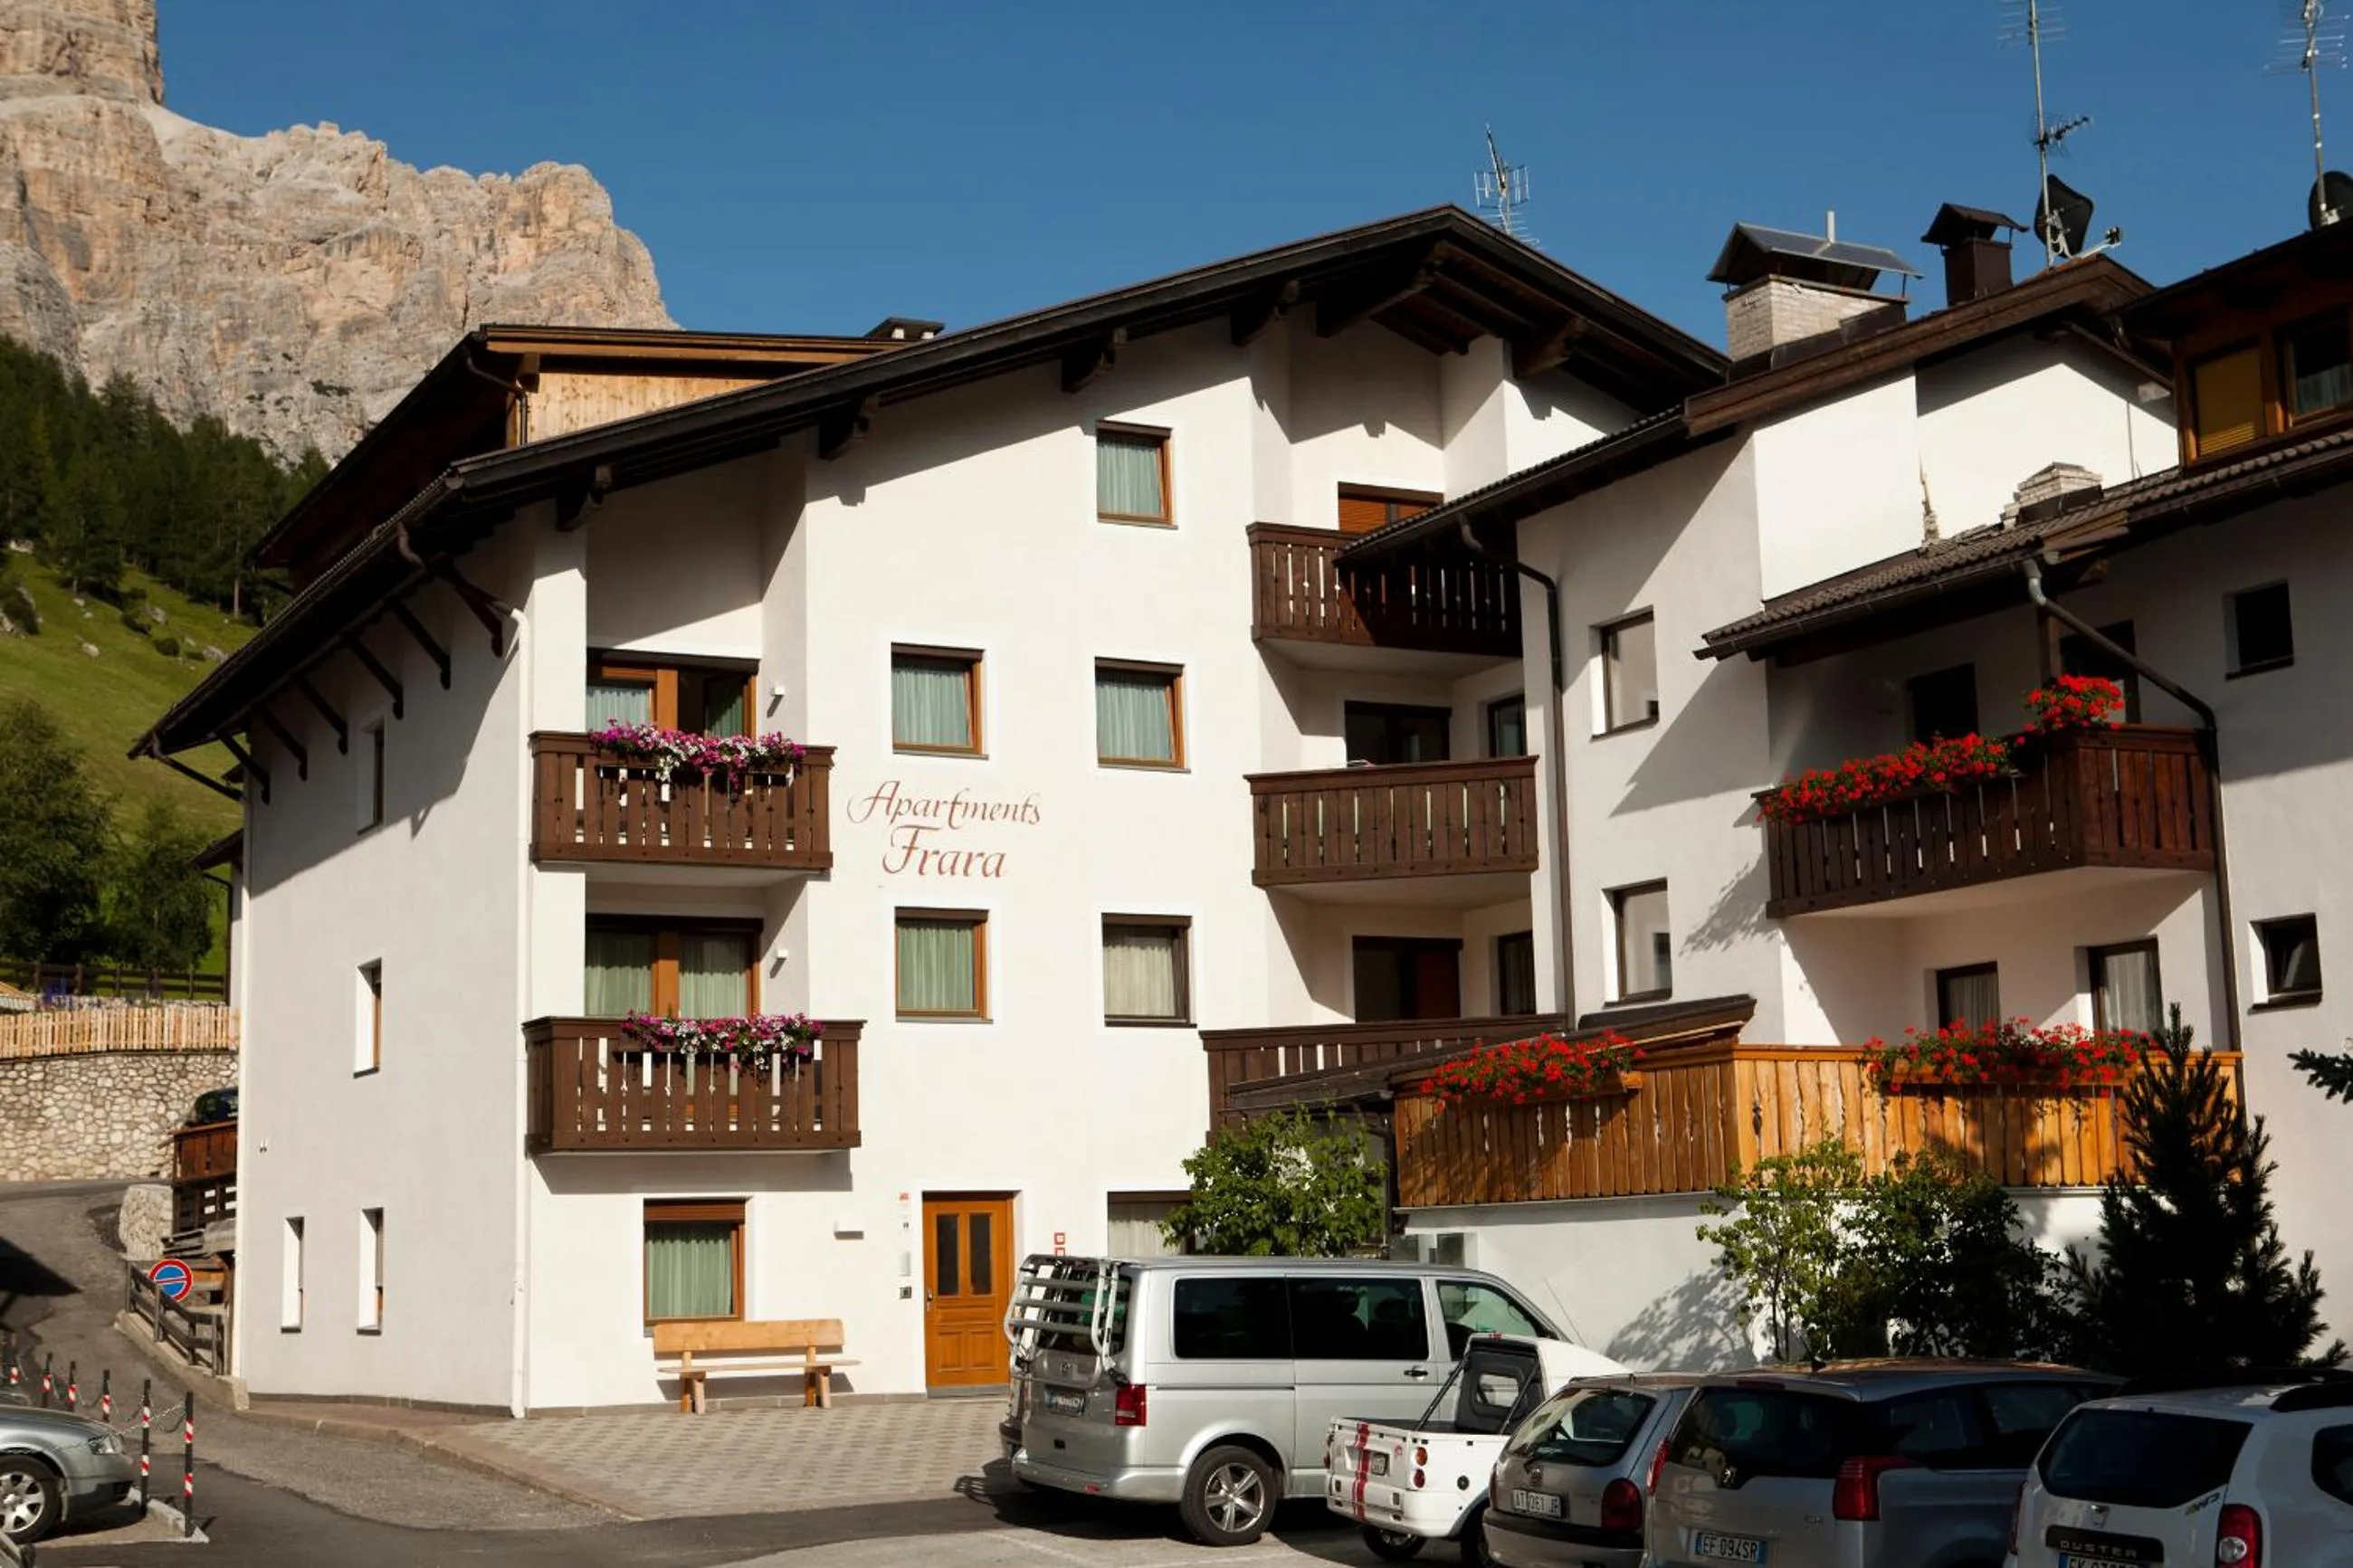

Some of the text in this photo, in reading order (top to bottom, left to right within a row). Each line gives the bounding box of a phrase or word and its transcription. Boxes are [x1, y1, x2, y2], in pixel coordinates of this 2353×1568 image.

[847, 780, 1040, 830] Apartments
[882, 824, 1006, 878] Frara
[1720, 1538, 1758, 1561] 094SR
[2060, 1540, 2137, 1557] DUSTER
